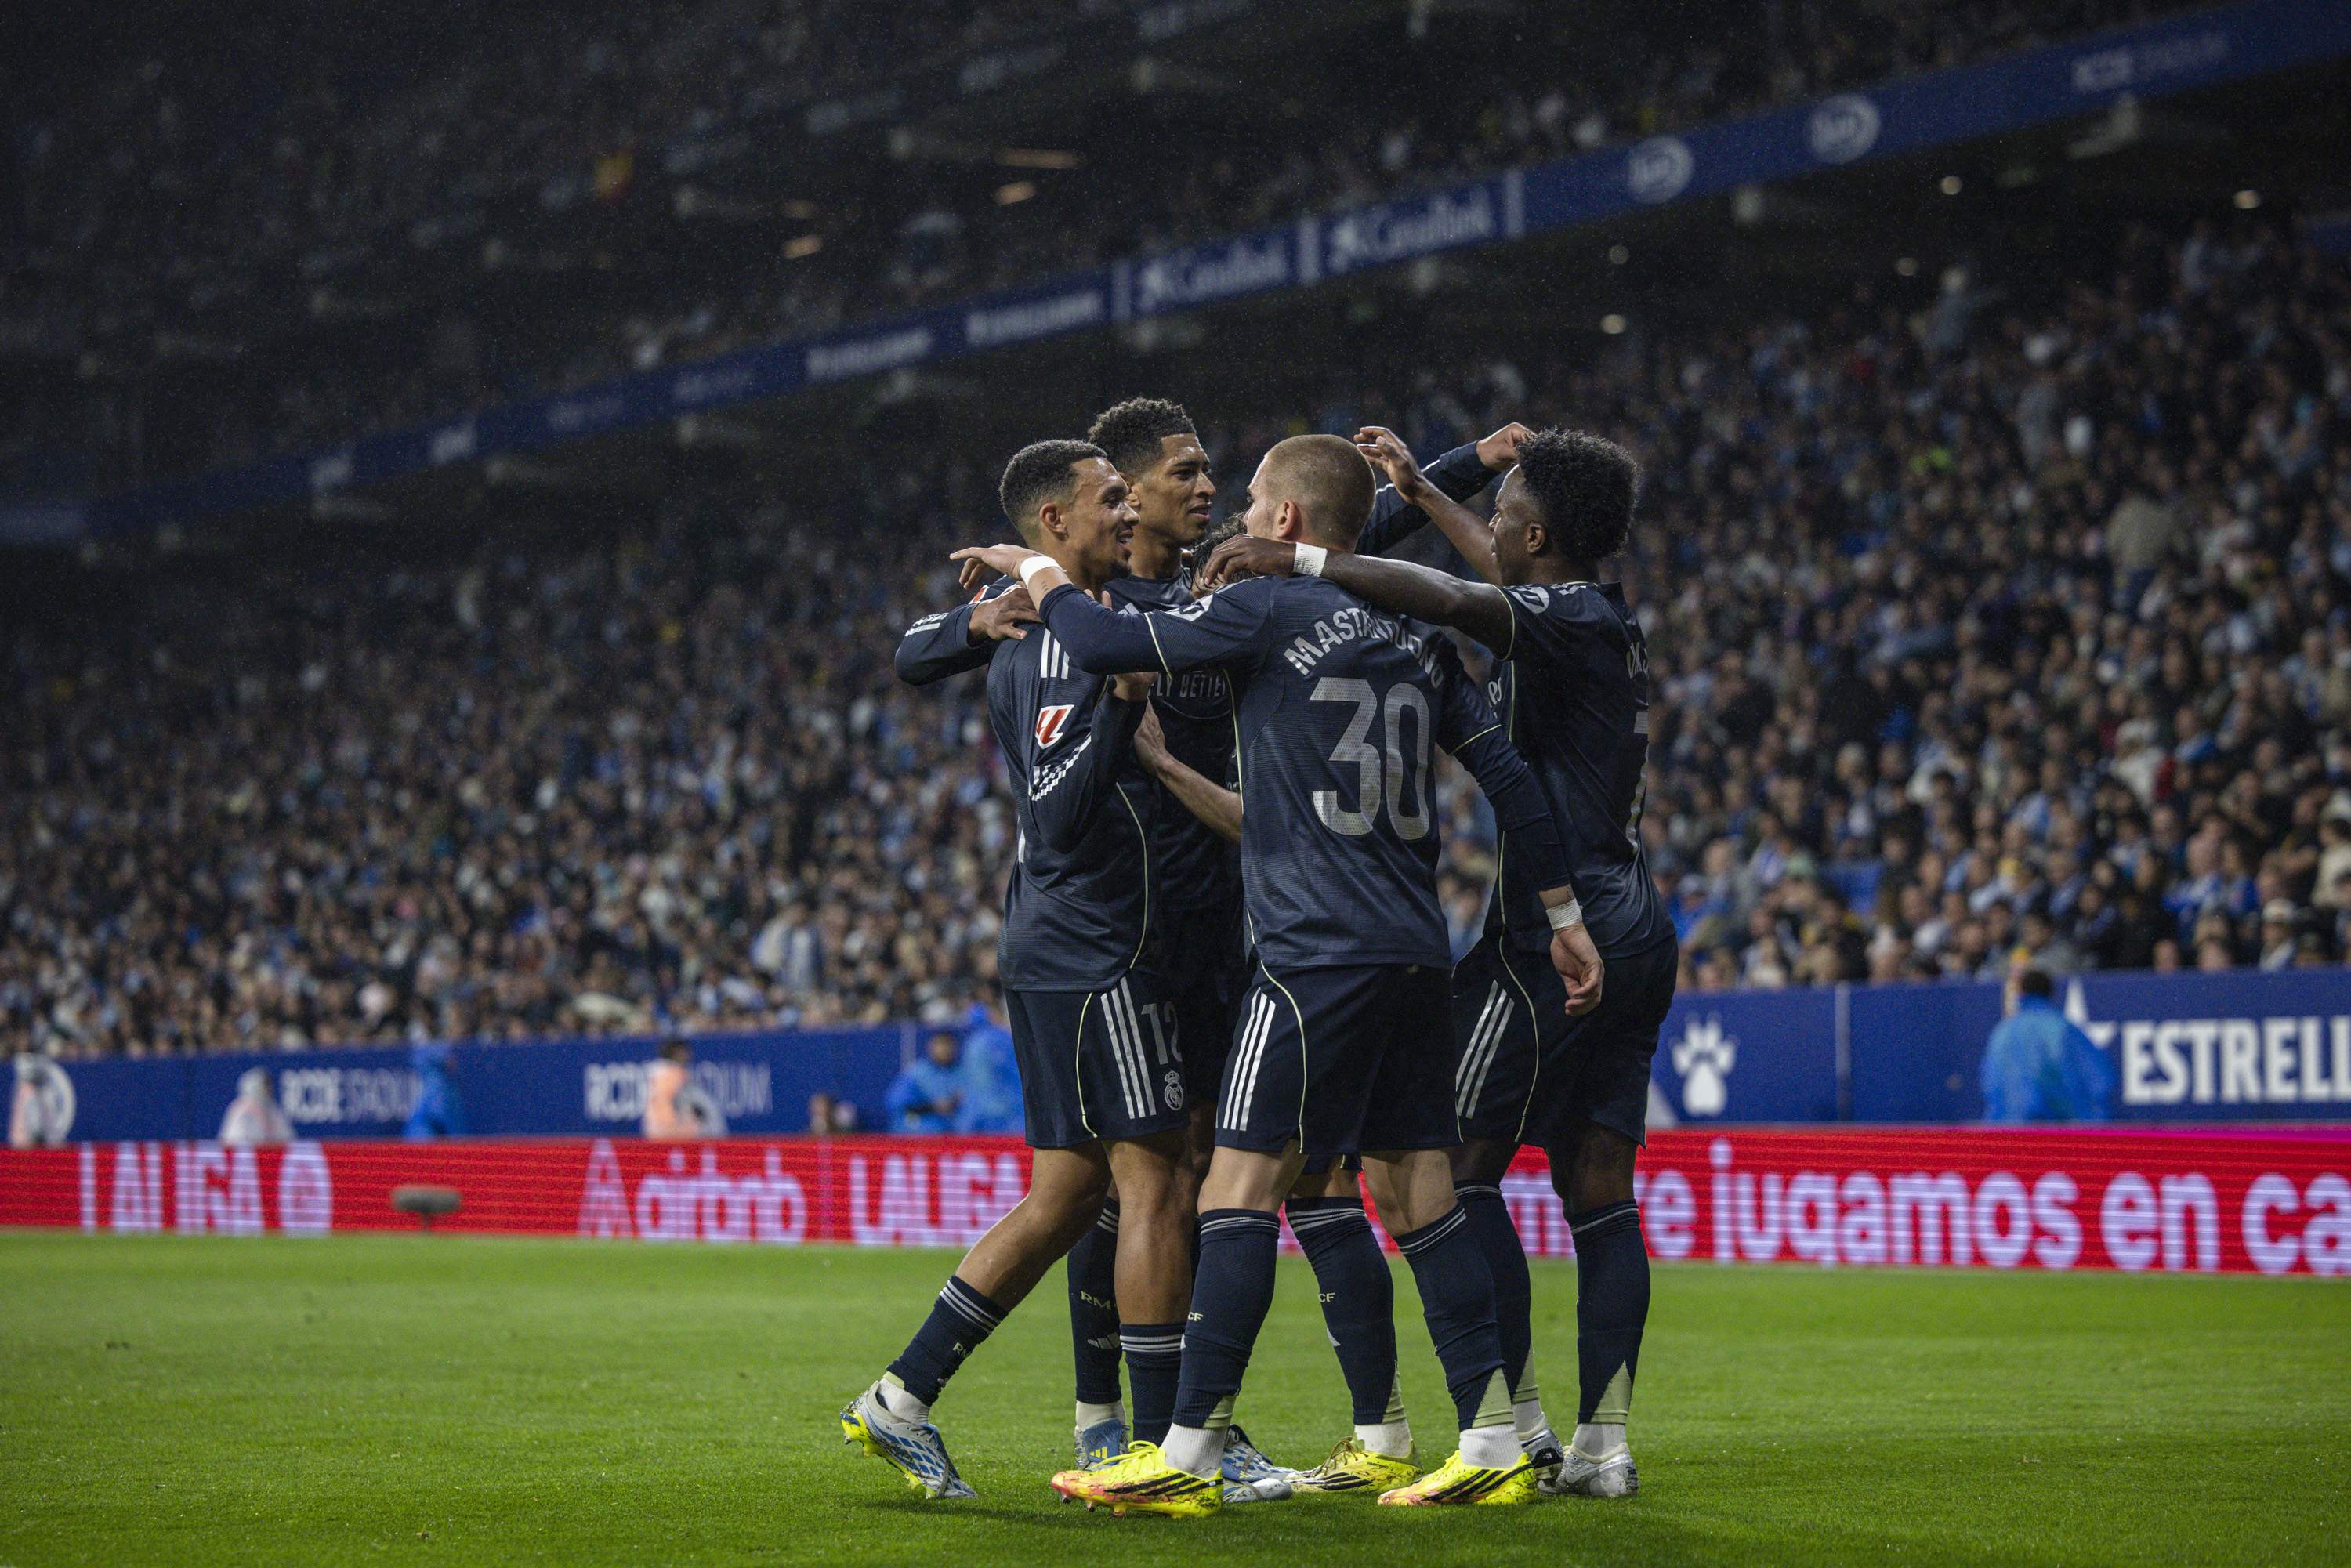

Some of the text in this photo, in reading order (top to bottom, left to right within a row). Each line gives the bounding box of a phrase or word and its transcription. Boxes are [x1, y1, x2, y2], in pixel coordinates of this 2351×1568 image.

[1147, 673, 1174, 697] LY
[1283, 607, 1444, 690] MASTANTUONO
[1309, 676, 1430, 841] 30
[1141, 1000, 1183, 1066] 12
[1708, 1138, 2085, 1269] jugamos
[2100, 1171, 2218, 1273] en
[2241, 1171, 2351, 1277] ca
